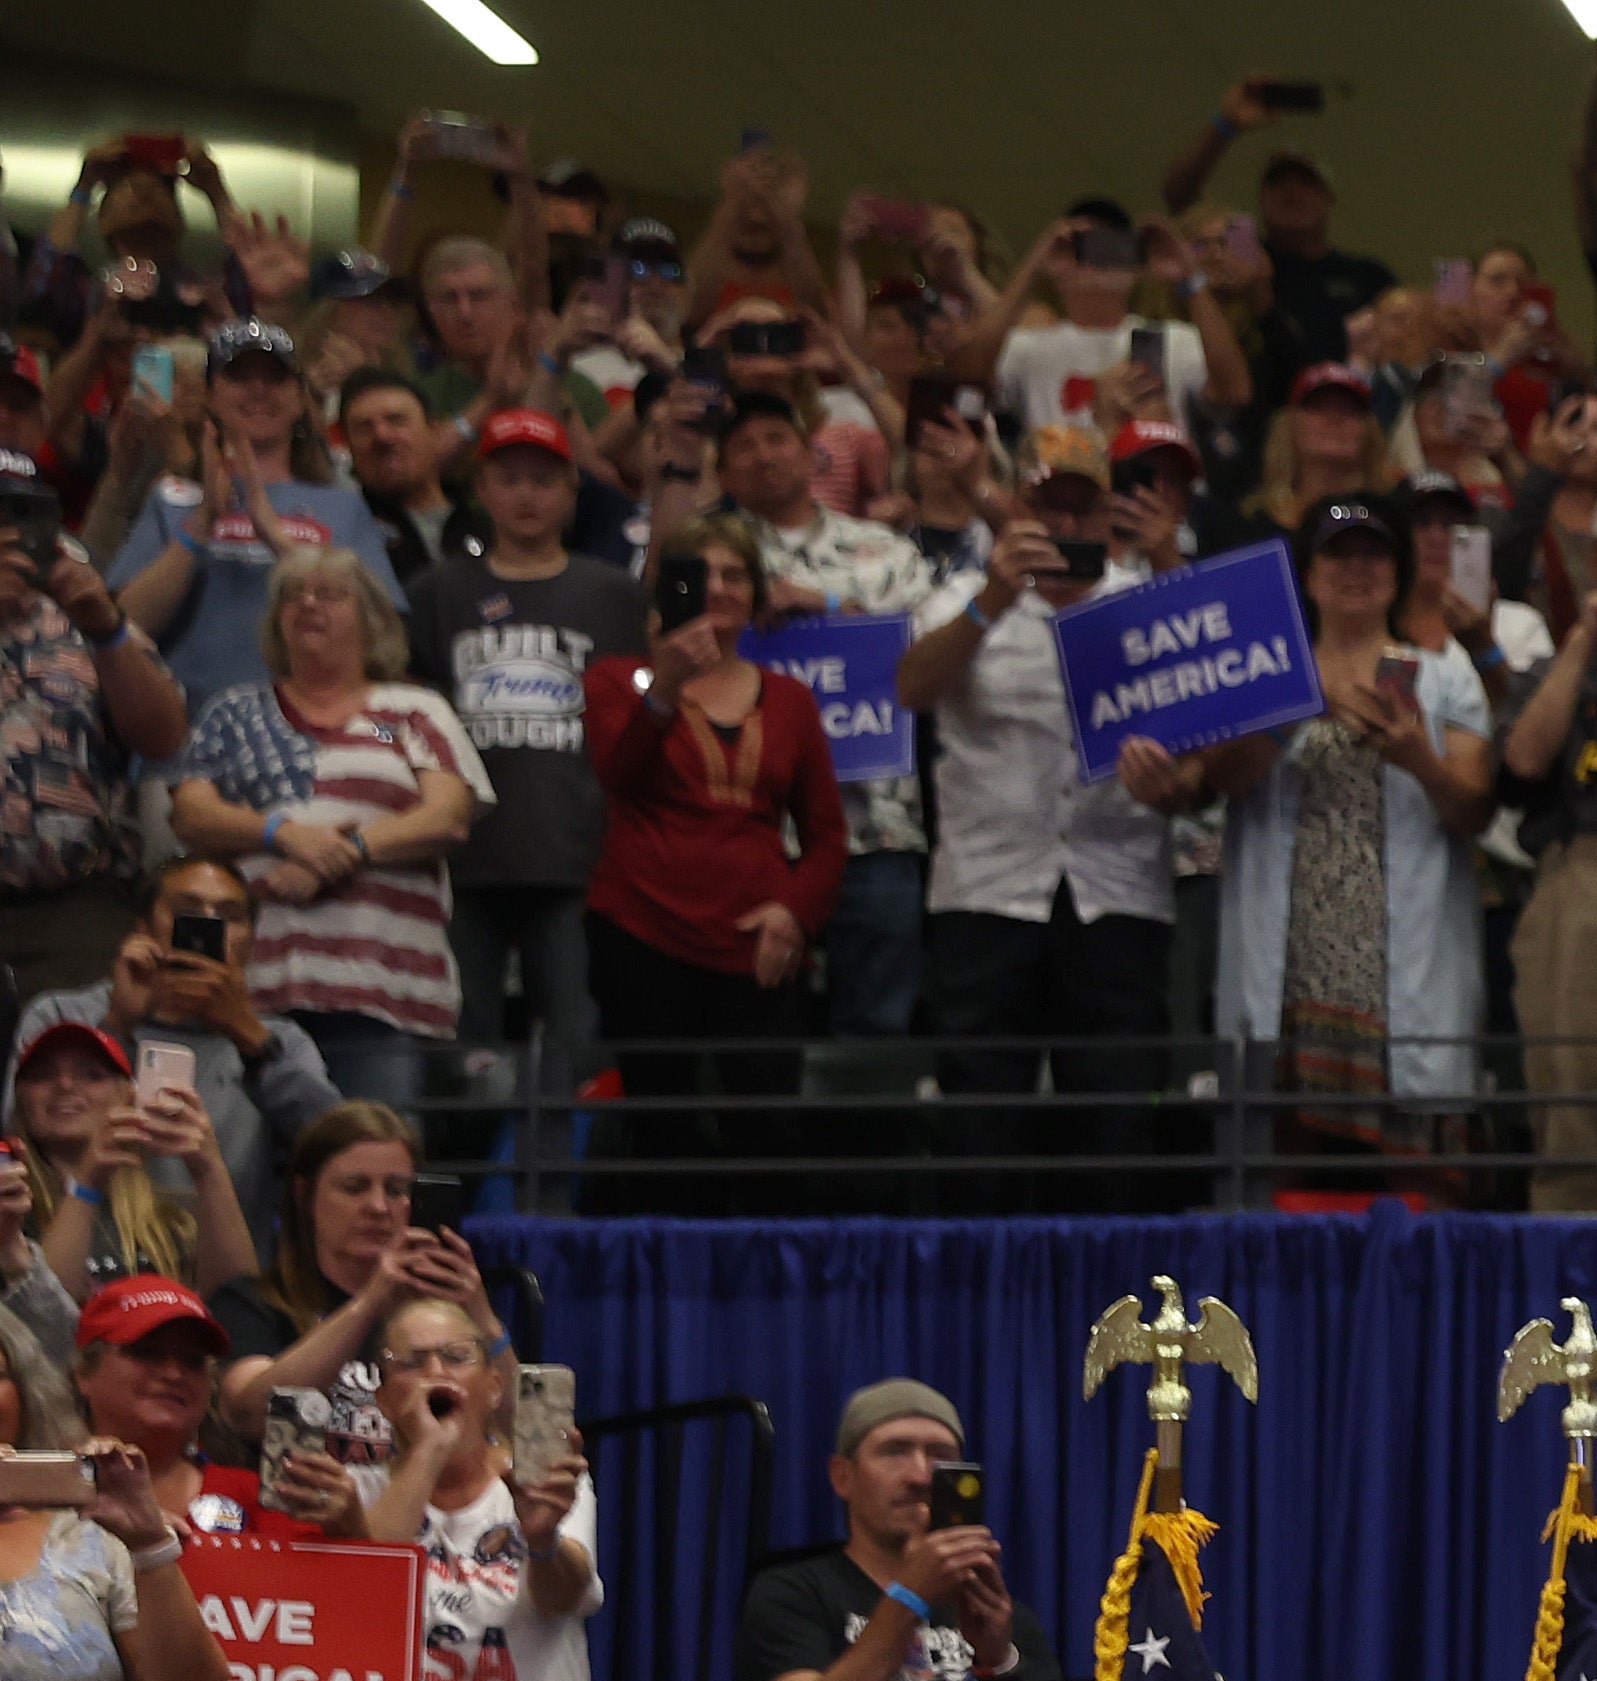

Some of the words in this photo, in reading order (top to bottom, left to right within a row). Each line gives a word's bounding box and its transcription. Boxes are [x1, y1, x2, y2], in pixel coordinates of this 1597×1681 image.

[1121, 600, 1234, 667] SAVE
[1091, 634, 1293, 732] AMERICA!
[198, 1593, 317, 1646] AVE
